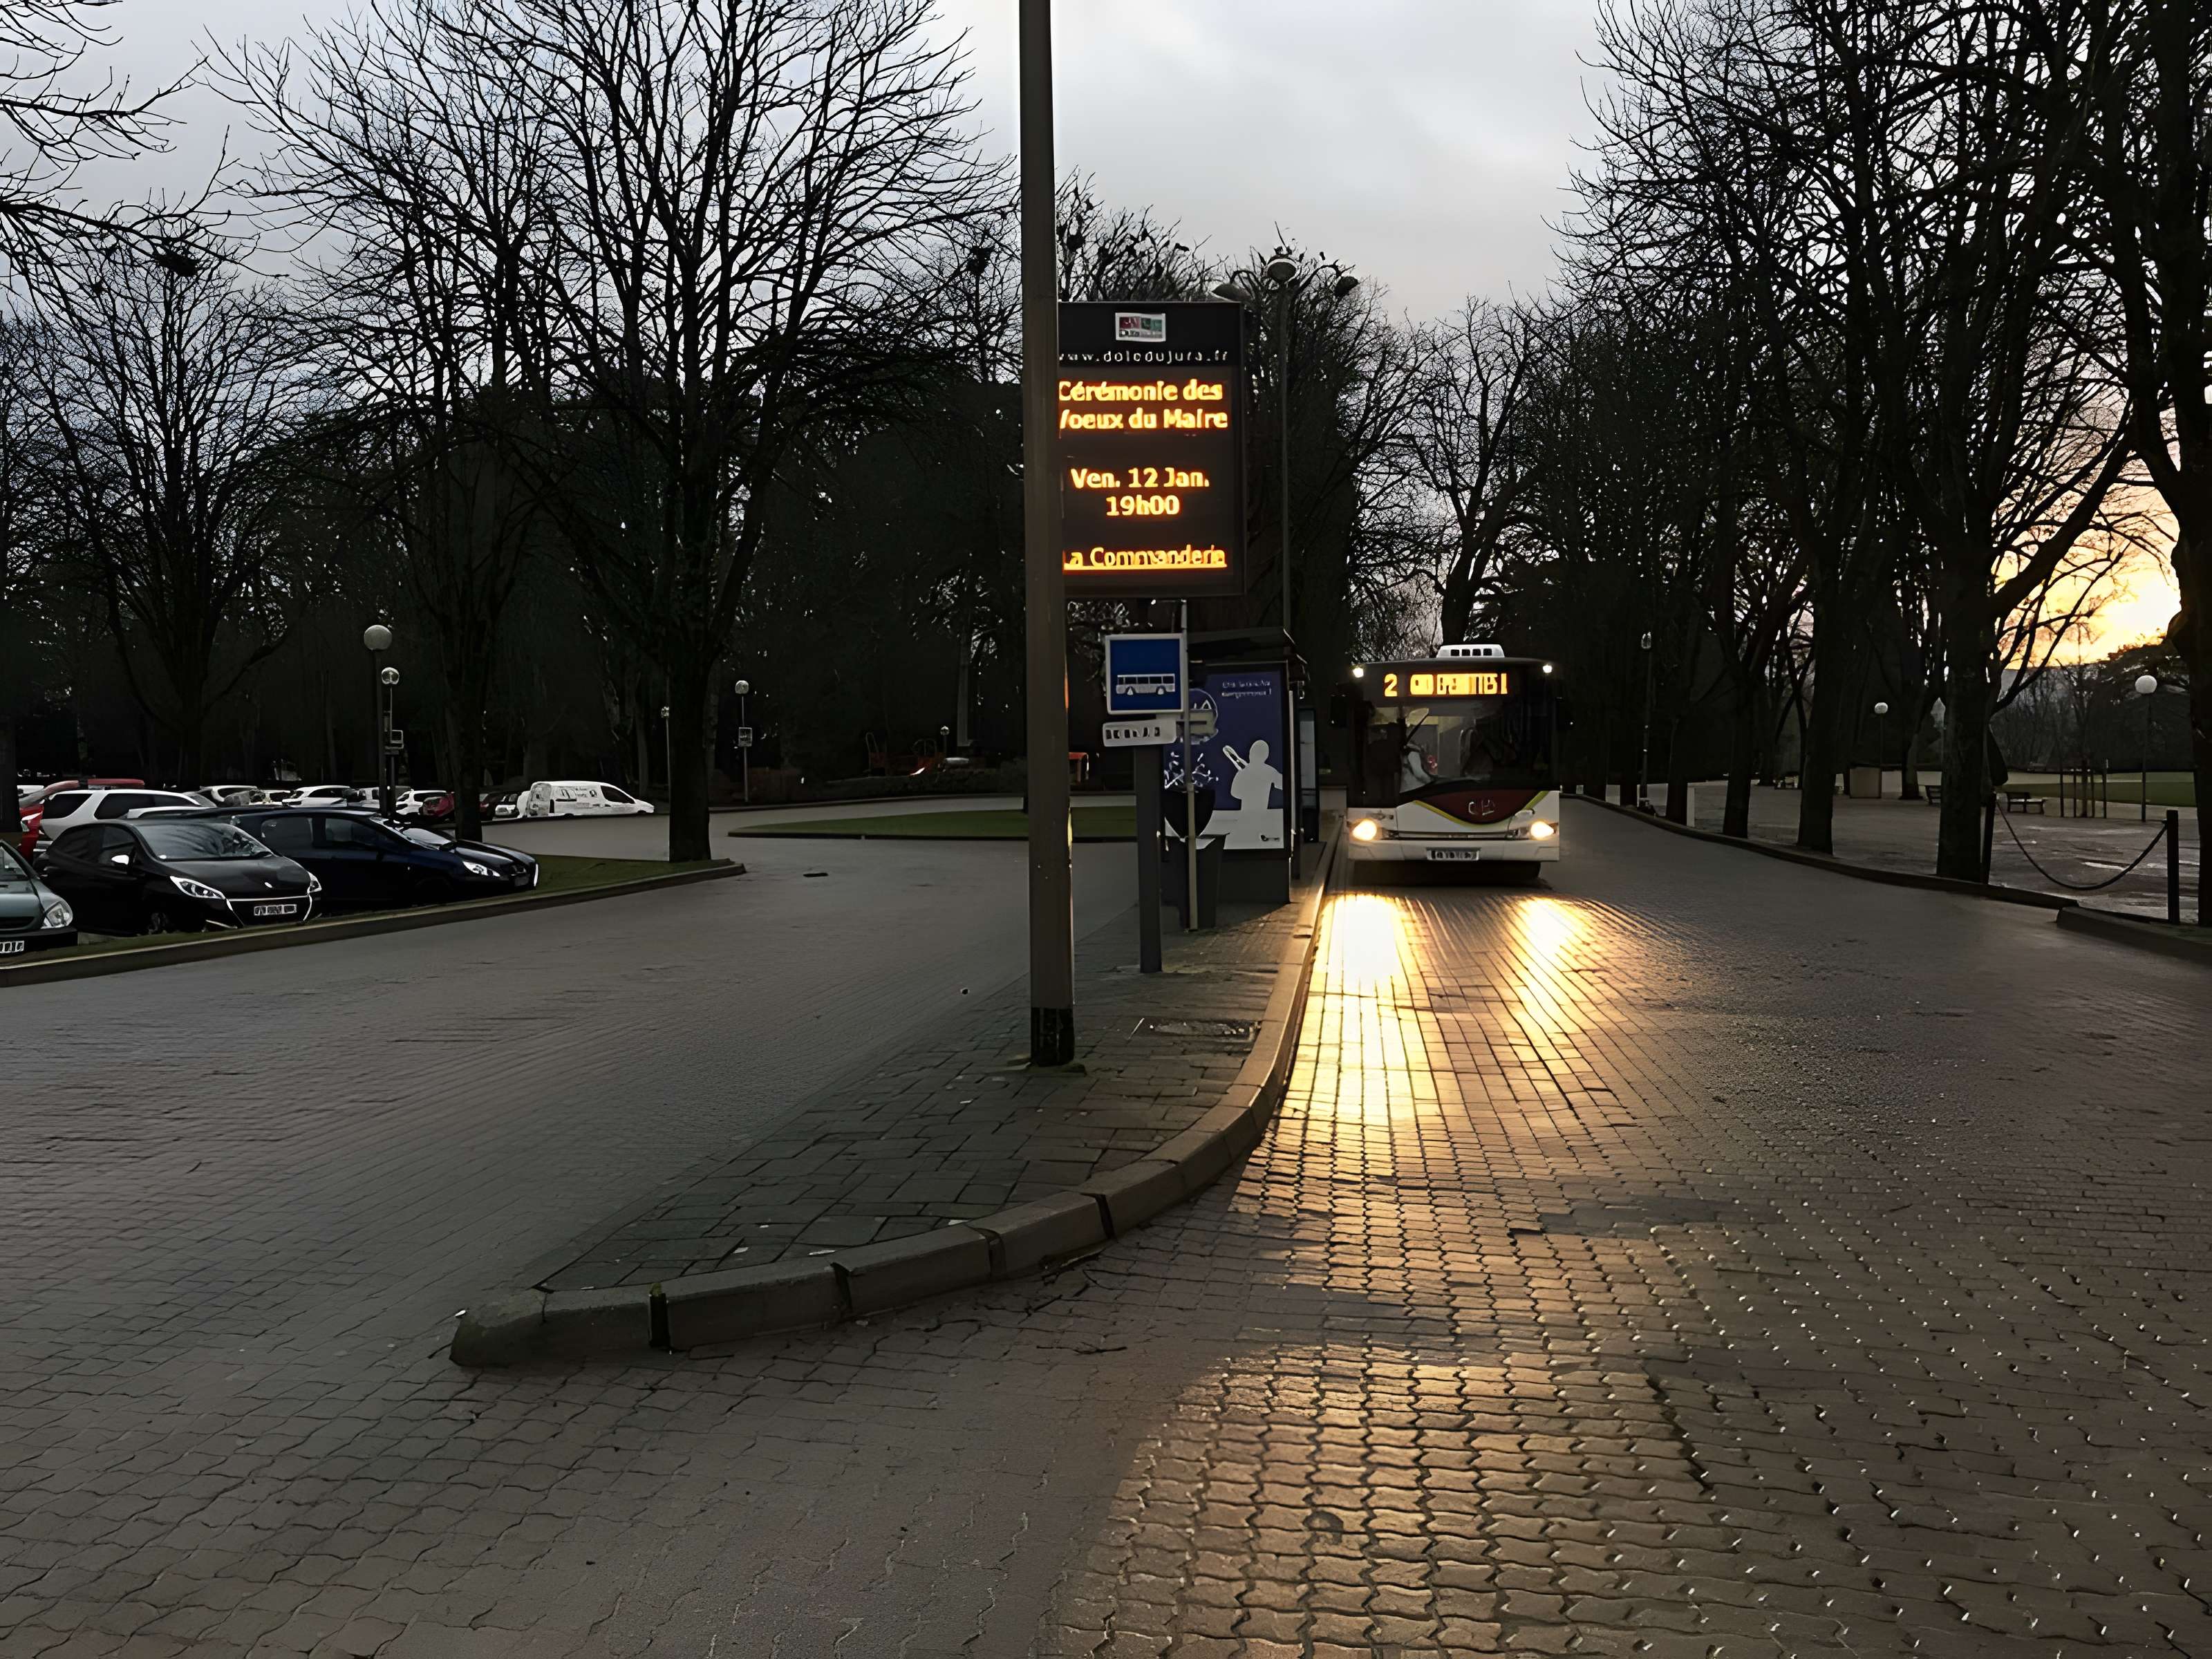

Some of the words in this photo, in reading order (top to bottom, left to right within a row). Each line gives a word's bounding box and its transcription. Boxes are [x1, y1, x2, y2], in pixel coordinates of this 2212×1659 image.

[1058, 380, 1179, 402] Cérémonie
[1183, 378, 1224, 401] des
[1128, 407, 1157, 429] du
[1163, 407, 1228, 429] Maire
[1071, 467, 1121, 489] Ven.
[1128, 467, 1159, 488] 12
[1163, 467, 1210, 487] Jan.
[1106, 494, 1180, 516] 19h00
[1384, 673, 1398, 697] 2
